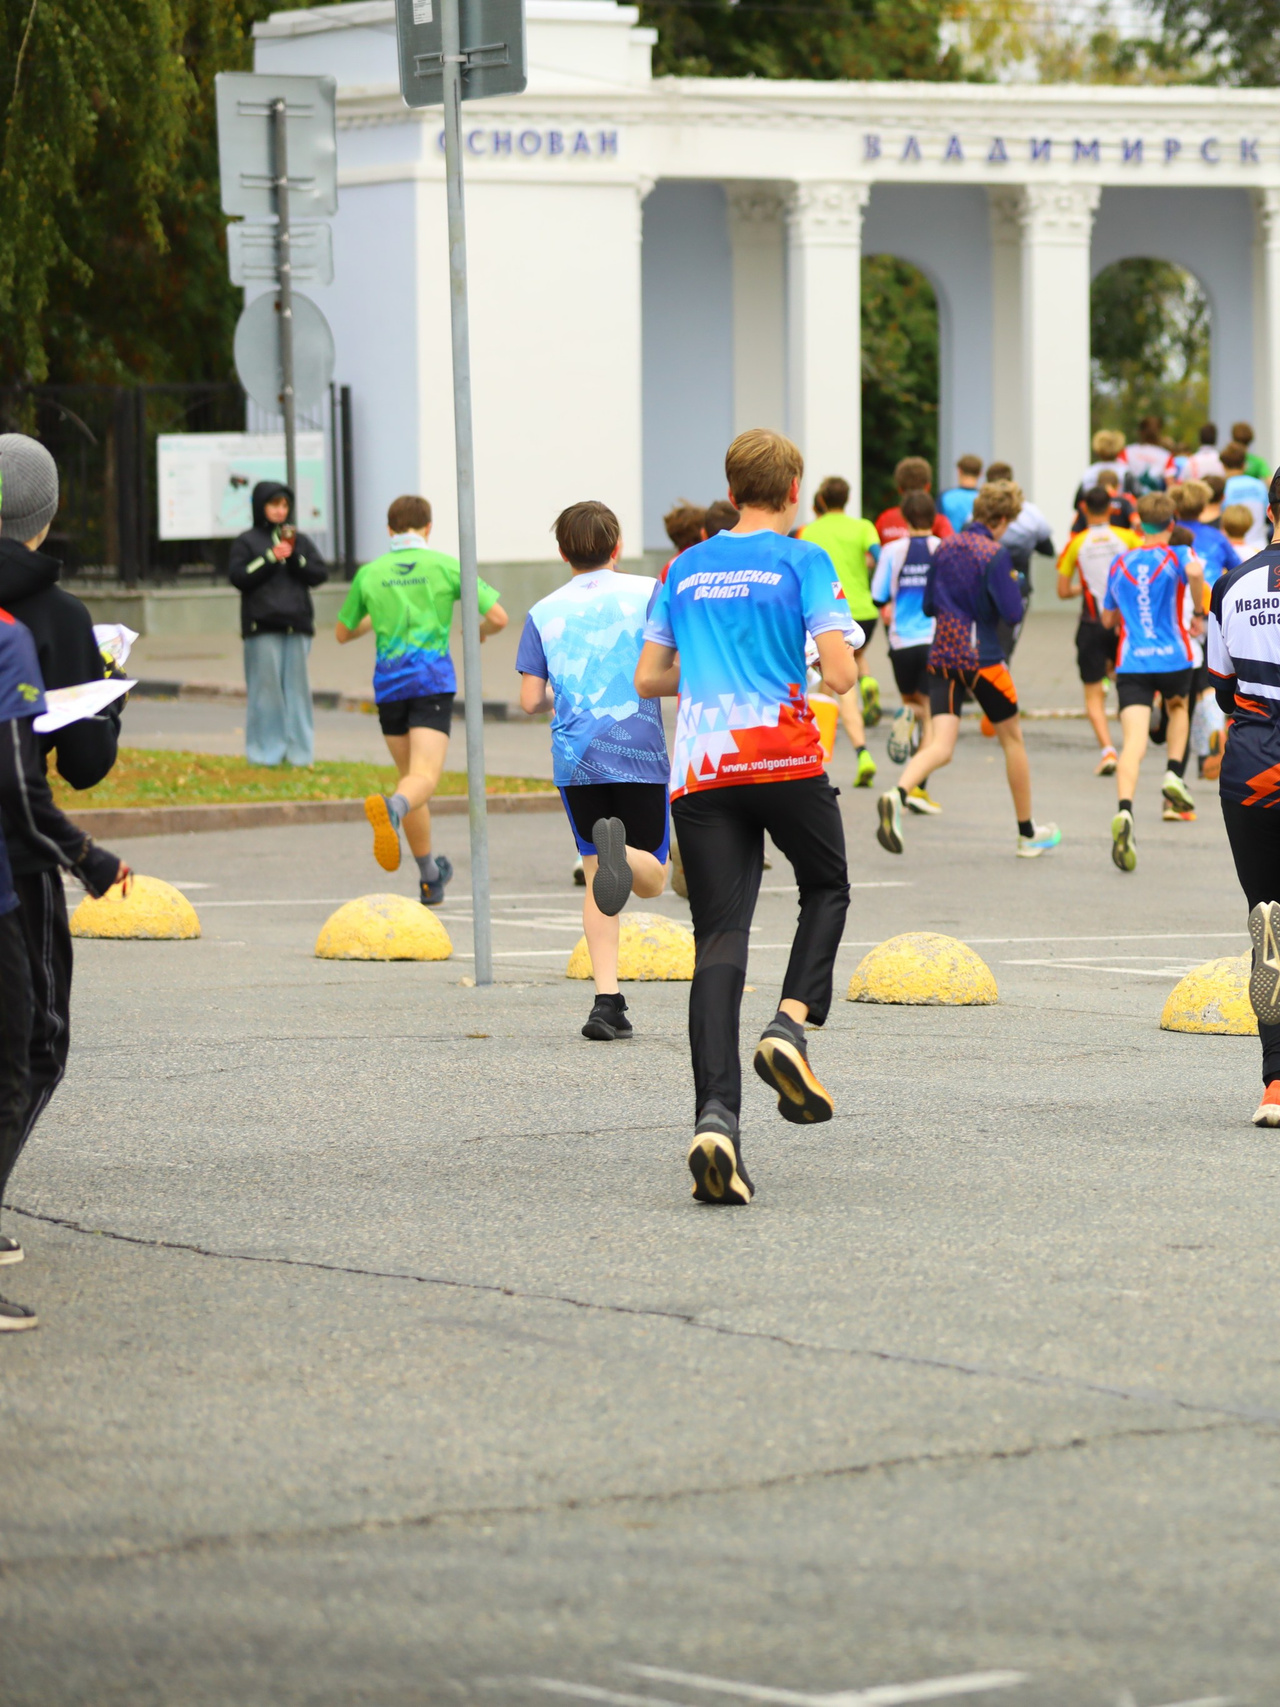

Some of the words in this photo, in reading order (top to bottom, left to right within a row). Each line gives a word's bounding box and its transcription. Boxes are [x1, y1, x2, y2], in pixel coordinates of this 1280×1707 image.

[676, 570, 782, 595] ВОЛГОГРАДСКАЯ
[693, 584, 750, 601] ОБЛАСТЬ
[722, 754, 818, 773] www.volgoorient.ru
